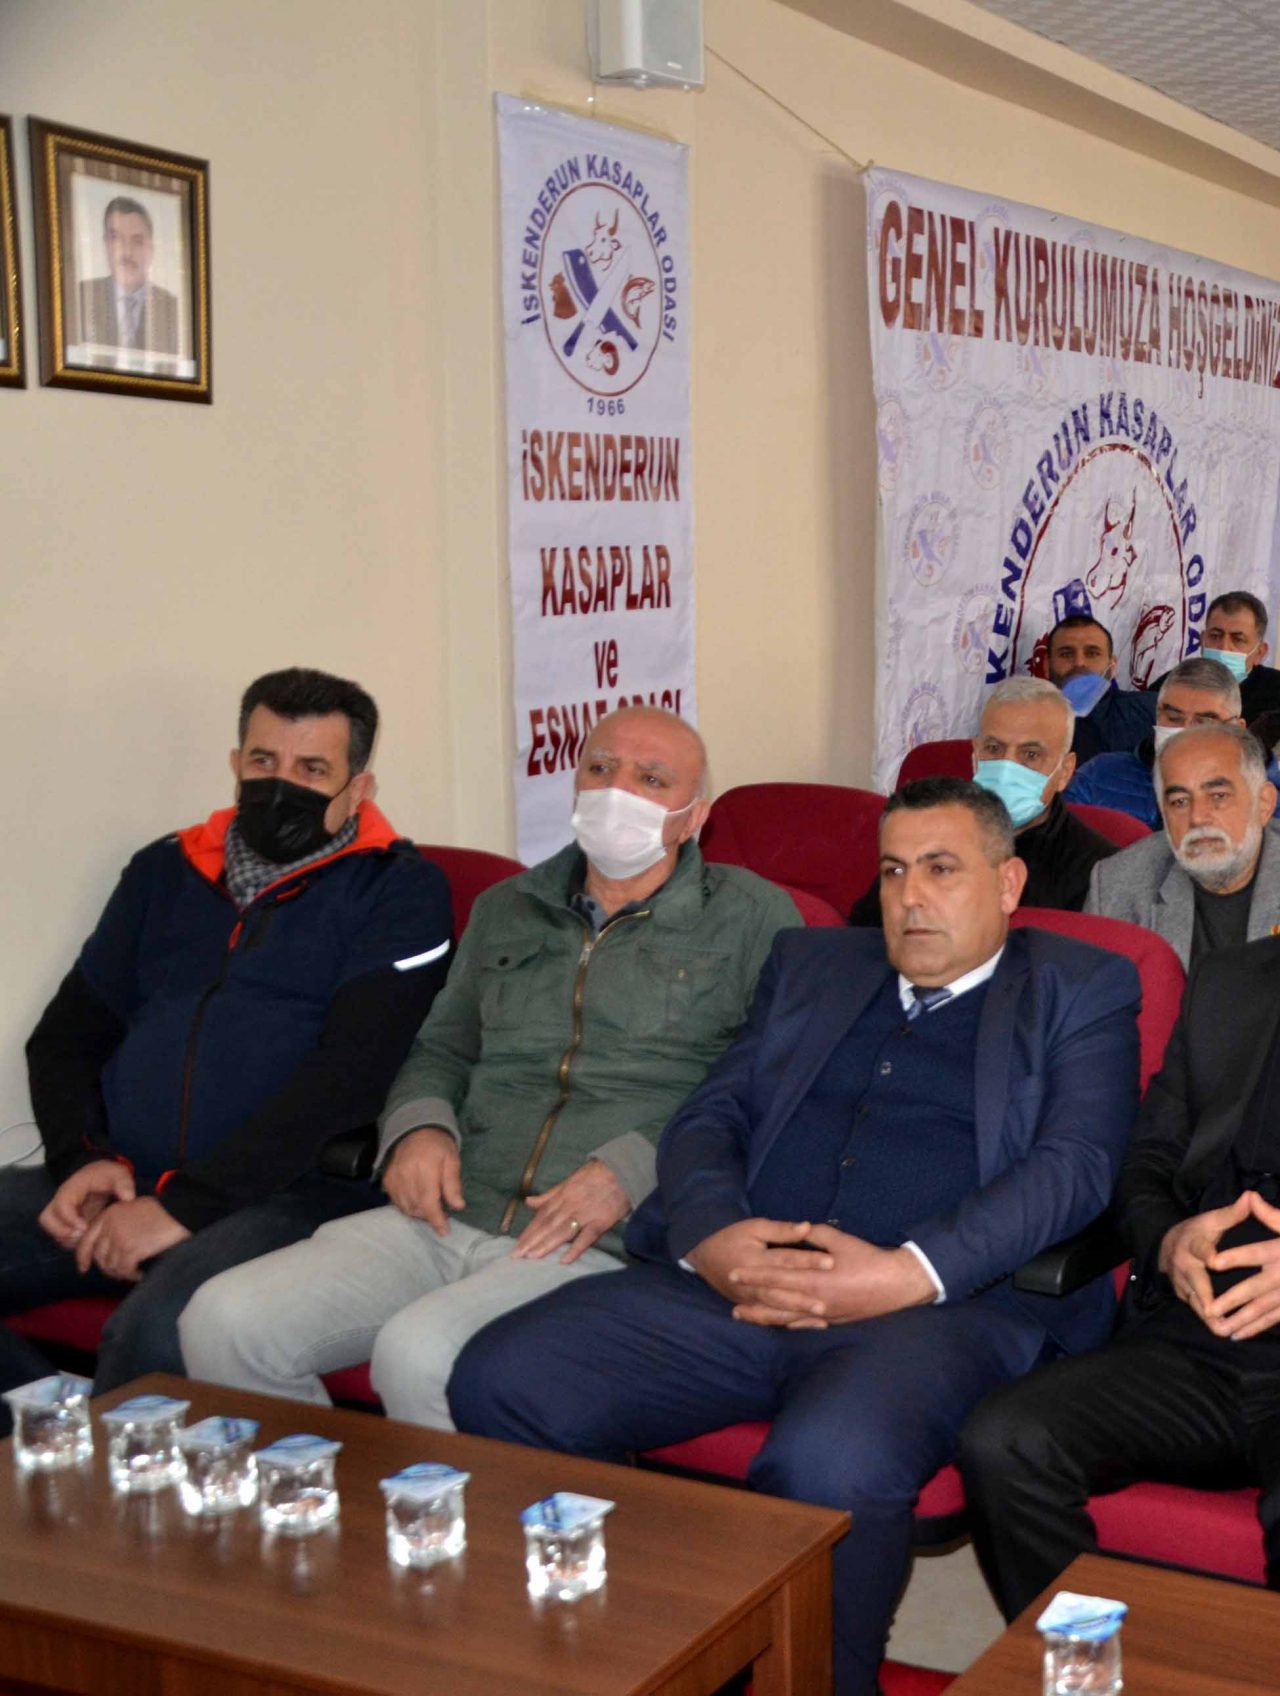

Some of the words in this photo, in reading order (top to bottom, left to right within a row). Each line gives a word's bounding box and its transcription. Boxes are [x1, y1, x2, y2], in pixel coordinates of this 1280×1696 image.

[521, 156, 580, 325] İSKENDERUN
[586, 154, 667, 249] KASAPLAR
[661, 255, 677, 342] ODASI
[879, 200, 984, 338] GENEL
[994, 226, 1162, 367] KURULUMUZA
[587, 398, 625, 416] 1966
[522, 429, 680, 501] İSKENDERUN
[985, 402, 1090, 684] KENDERUN
[1100, 391, 1197, 544] KASAPLAR
[1185, 554, 1206, 656] ODA
[541, 544, 671, 617] KASAPLAR
[594, 639, 619, 688] ve
